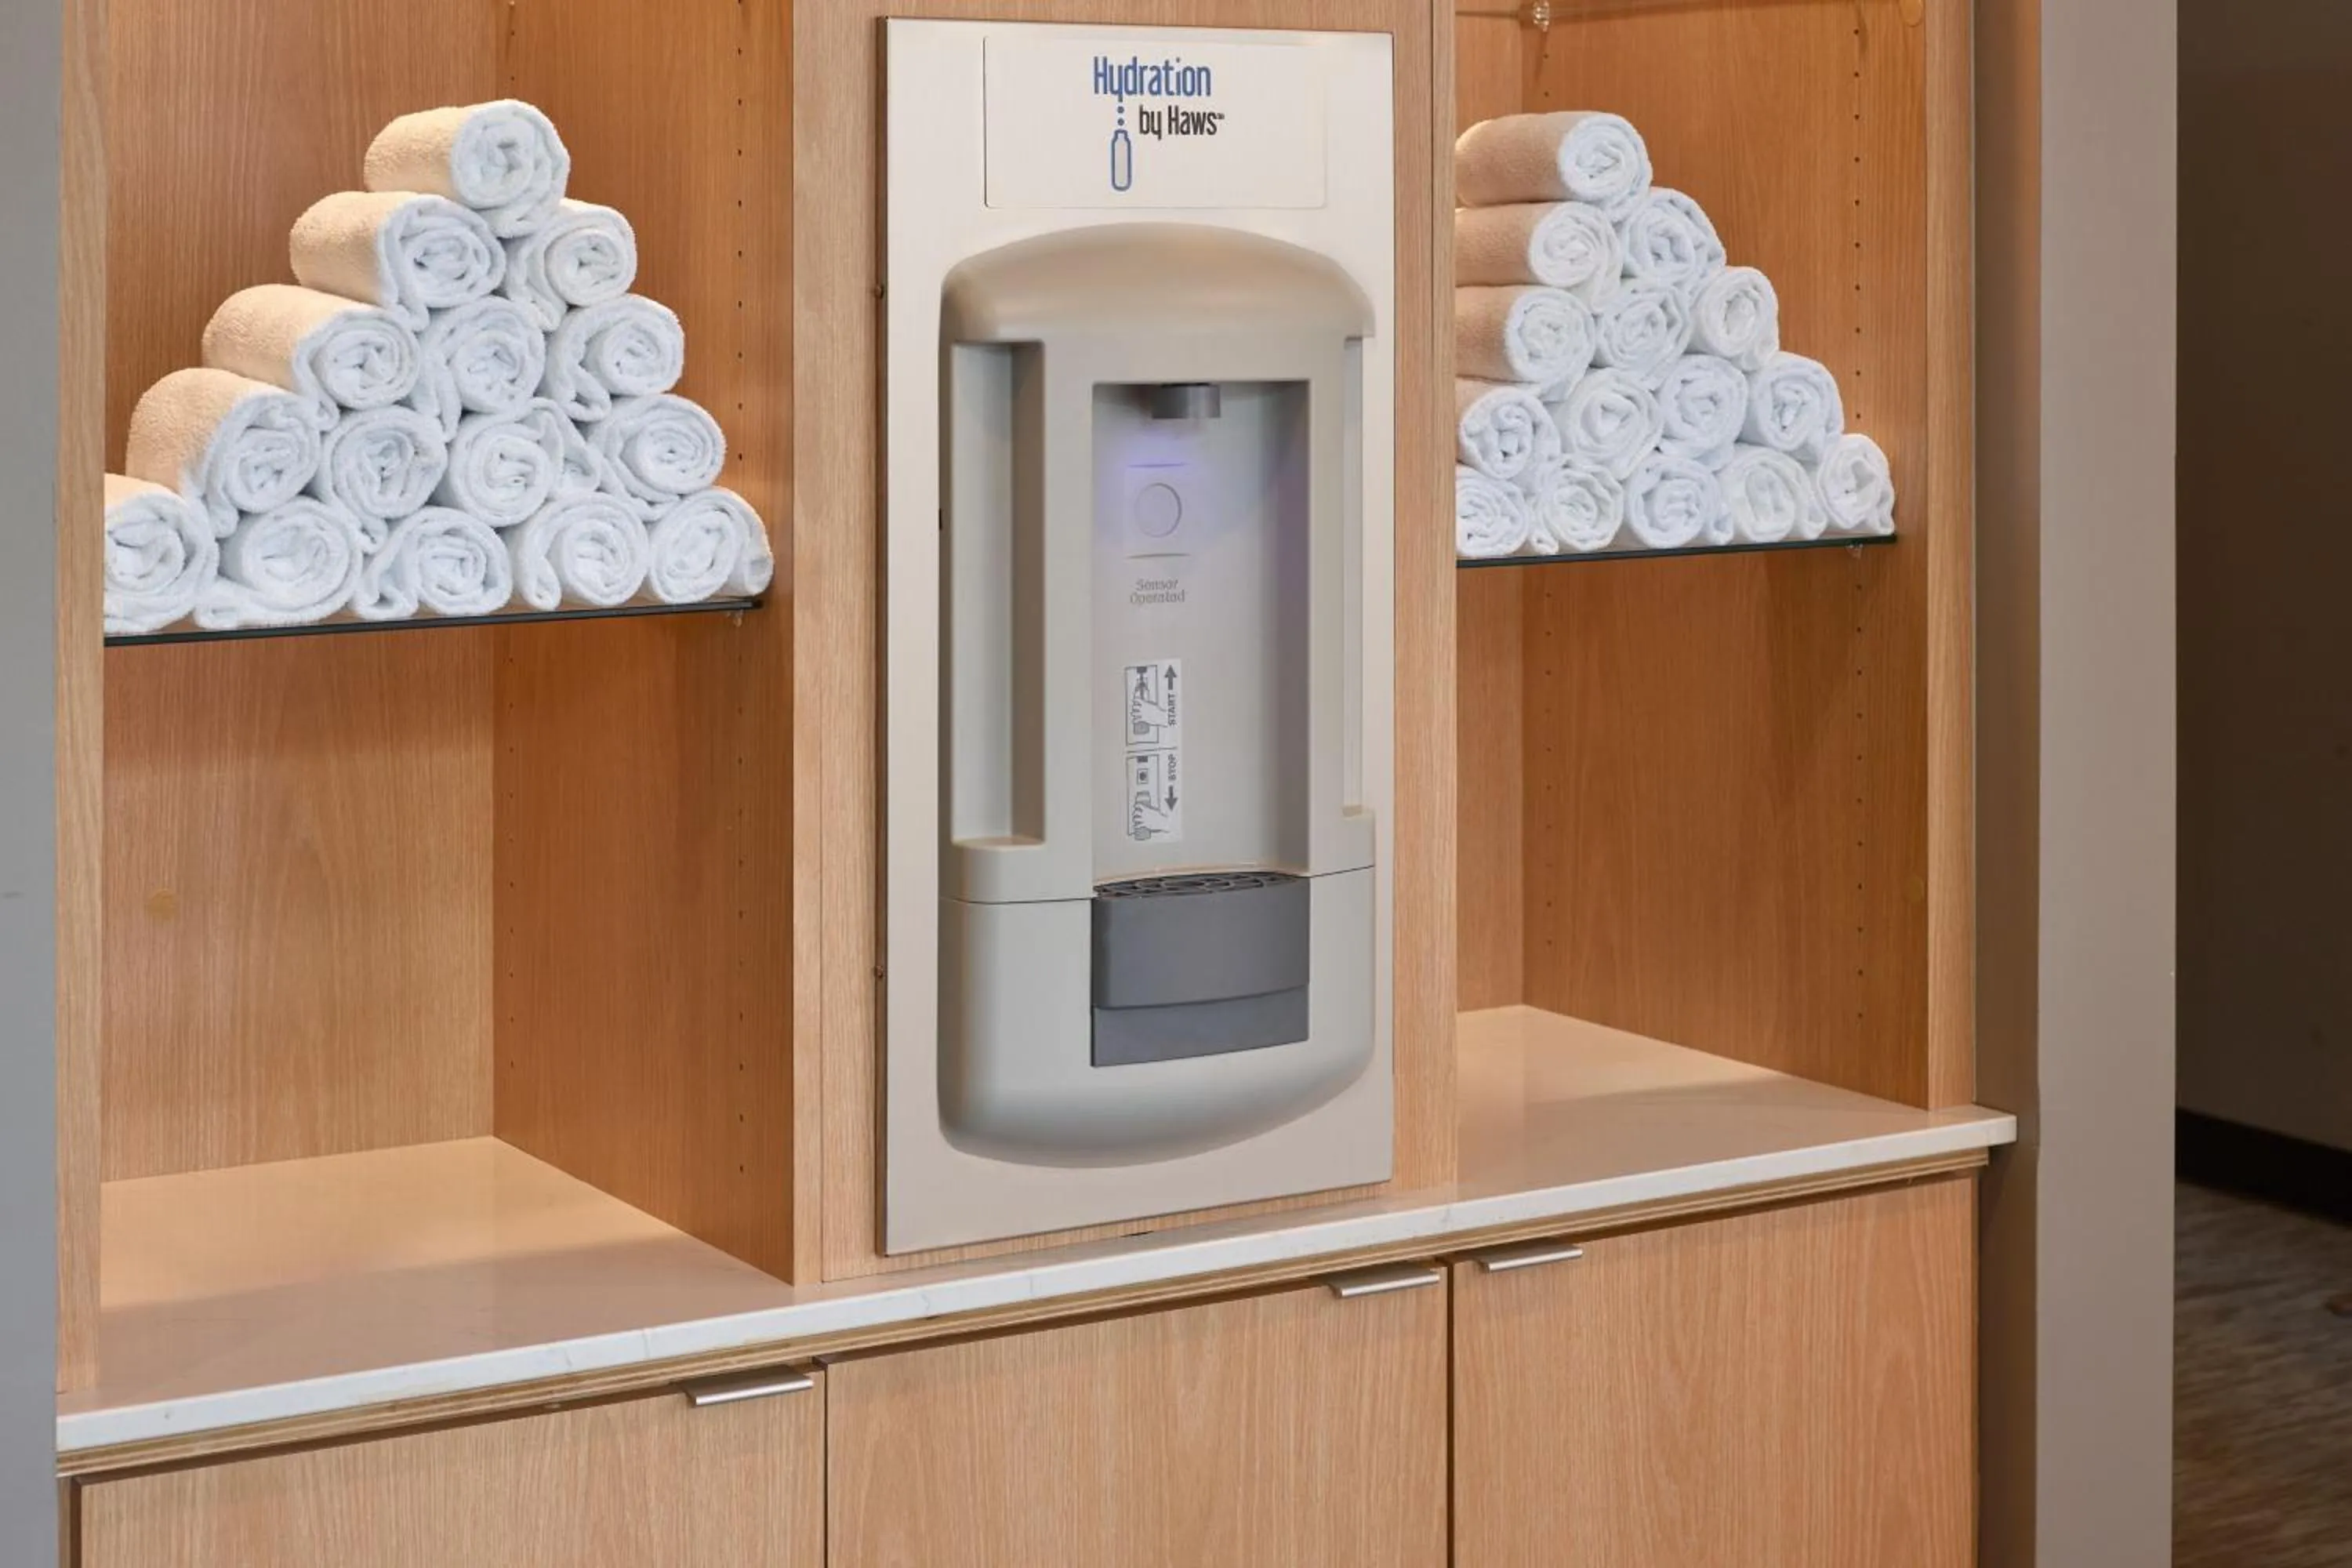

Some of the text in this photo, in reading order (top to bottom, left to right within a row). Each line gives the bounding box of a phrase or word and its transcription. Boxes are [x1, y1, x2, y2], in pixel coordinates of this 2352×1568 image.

[1093, 56, 1211, 102] Hydration
[1139, 104, 1162, 141] by
[1134, 579, 1179, 591] Sensor
[1167, 693, 1176, 727] START
[1167, 753, 1176, 781] STOP
